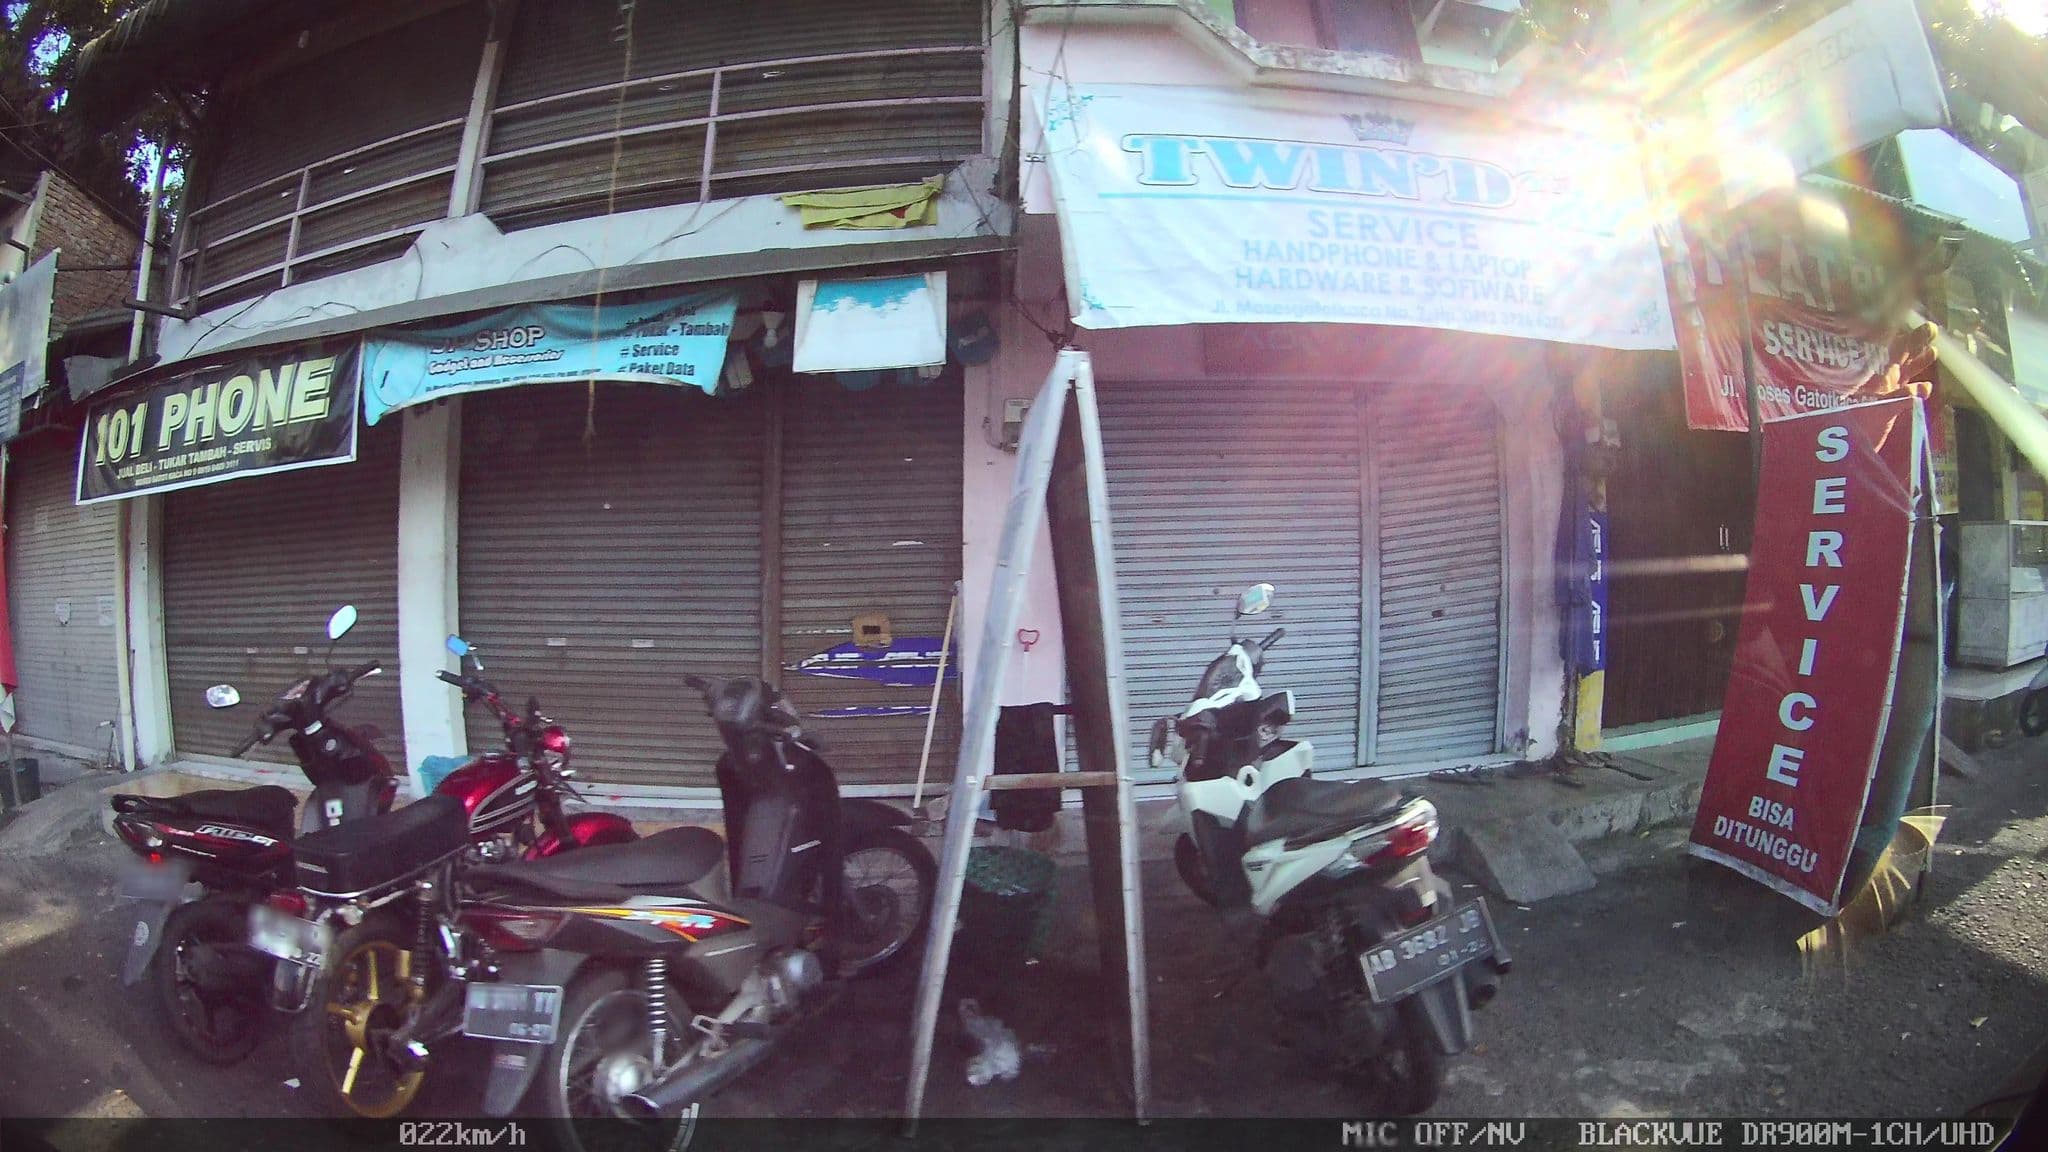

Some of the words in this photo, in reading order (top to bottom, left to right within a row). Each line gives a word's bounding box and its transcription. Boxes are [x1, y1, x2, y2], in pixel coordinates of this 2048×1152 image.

[1308, 210, 1480, 250] SERVICE
[1243, 240, 1419, 268] HANDPHONE
[1426, 251, 1440, 272] &
[1450, 253, 1530, 280] LAPTOP
[1235, 266, 1392, 295] HARDWARE
[1400, 275, 1415, 296] &
[1423, 275, 1545, 306] SOFTWARE
[473, 325, 546, 352] SHOP
[632, 342, 680, 358] Service
[1762, 319, 1865, 371] SERVICE
[629, 362, 663, 375] Paket
[667, 361, 695, 377] Data
[96, 401, 148, 466] 101
[158, 355, 337, 451] PHONE
[1757, 384, 1791, 406] oses
[117, 466, 135, 479] JUAL
[159, 455, 188, 471] TUKAR
[189, 447, 227, 465] TAMBAH
[233, 438, 272, 455] SERVIS
[1765, 425, 1850, 788] SERVICE
[1748, 795, 1794, 831] BISA
[1713, 815, 1818, 873] DITUNGGU
